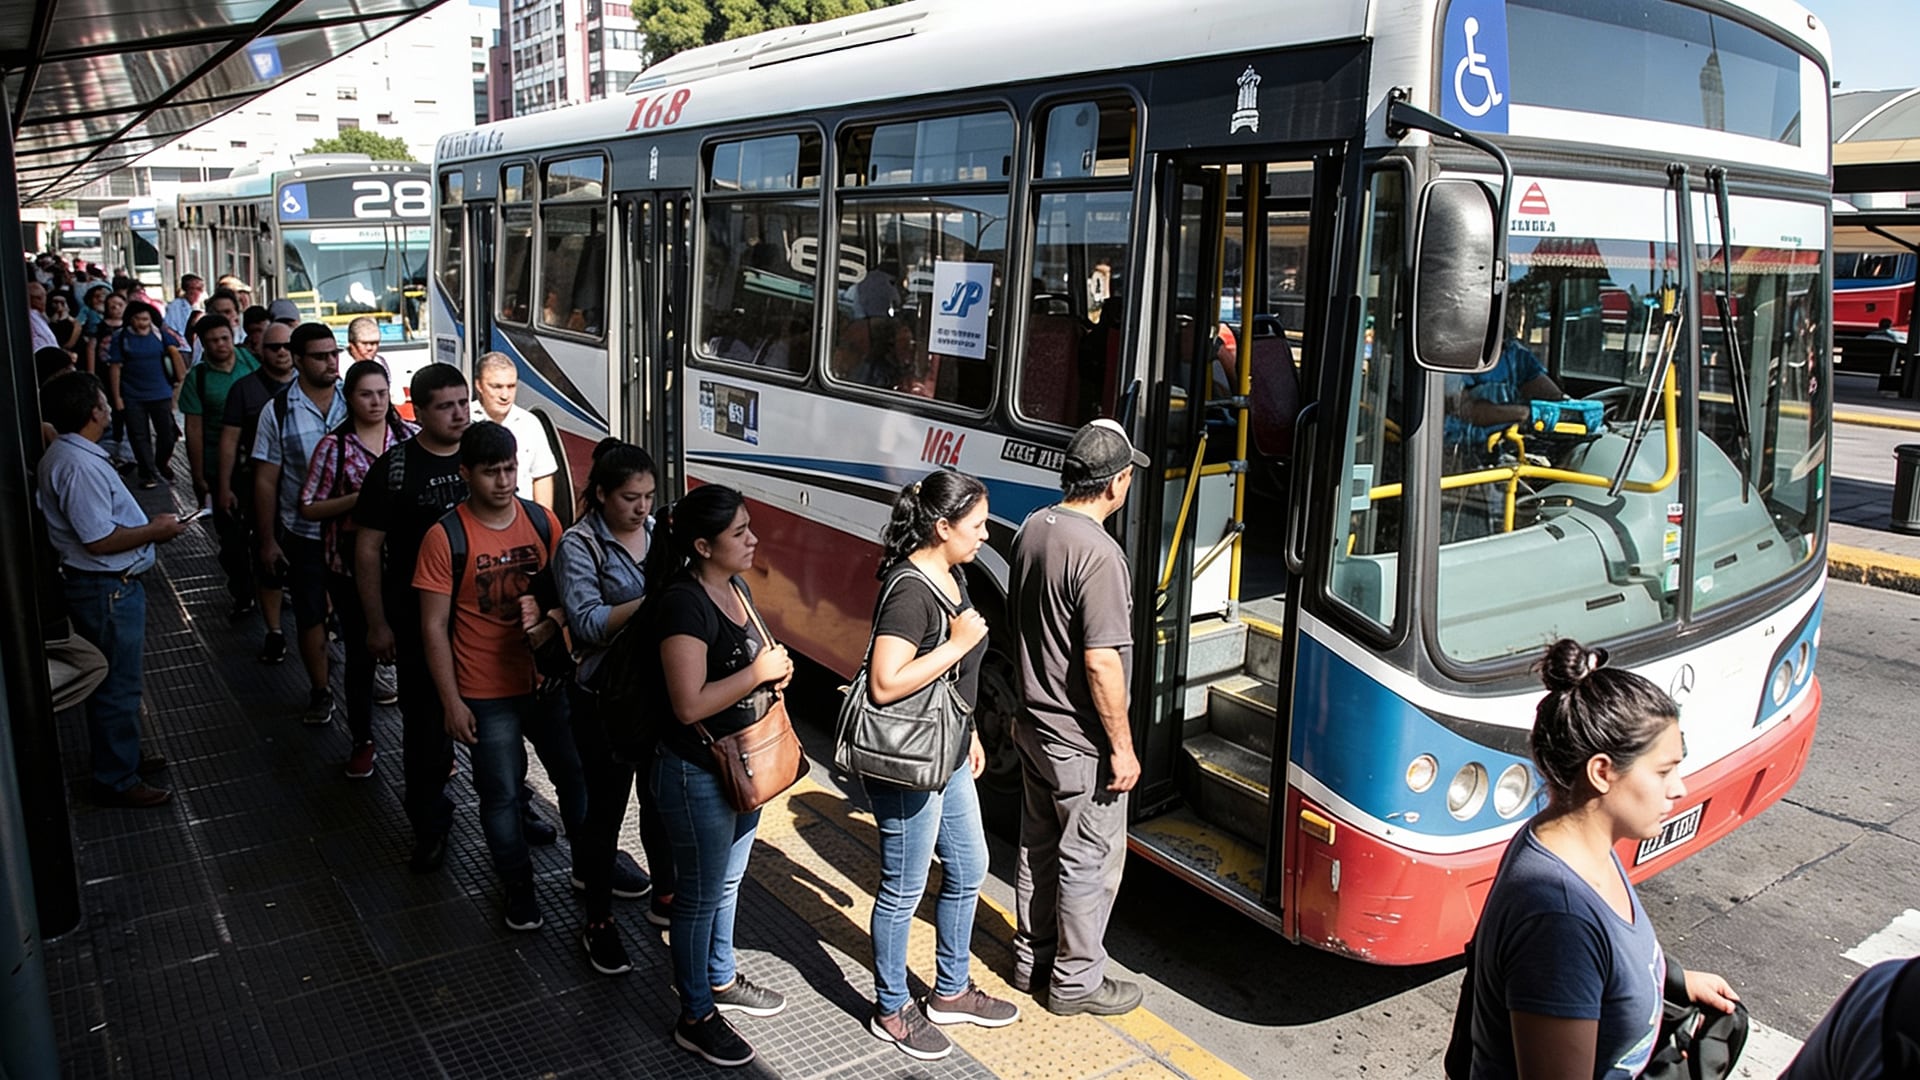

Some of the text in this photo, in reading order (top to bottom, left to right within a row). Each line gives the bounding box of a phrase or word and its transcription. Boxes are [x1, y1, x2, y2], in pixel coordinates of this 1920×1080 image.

[626, 88, 691, 132] 168
[352, 180, 431, 218] 28
[940, 281, 984, 318] JP
